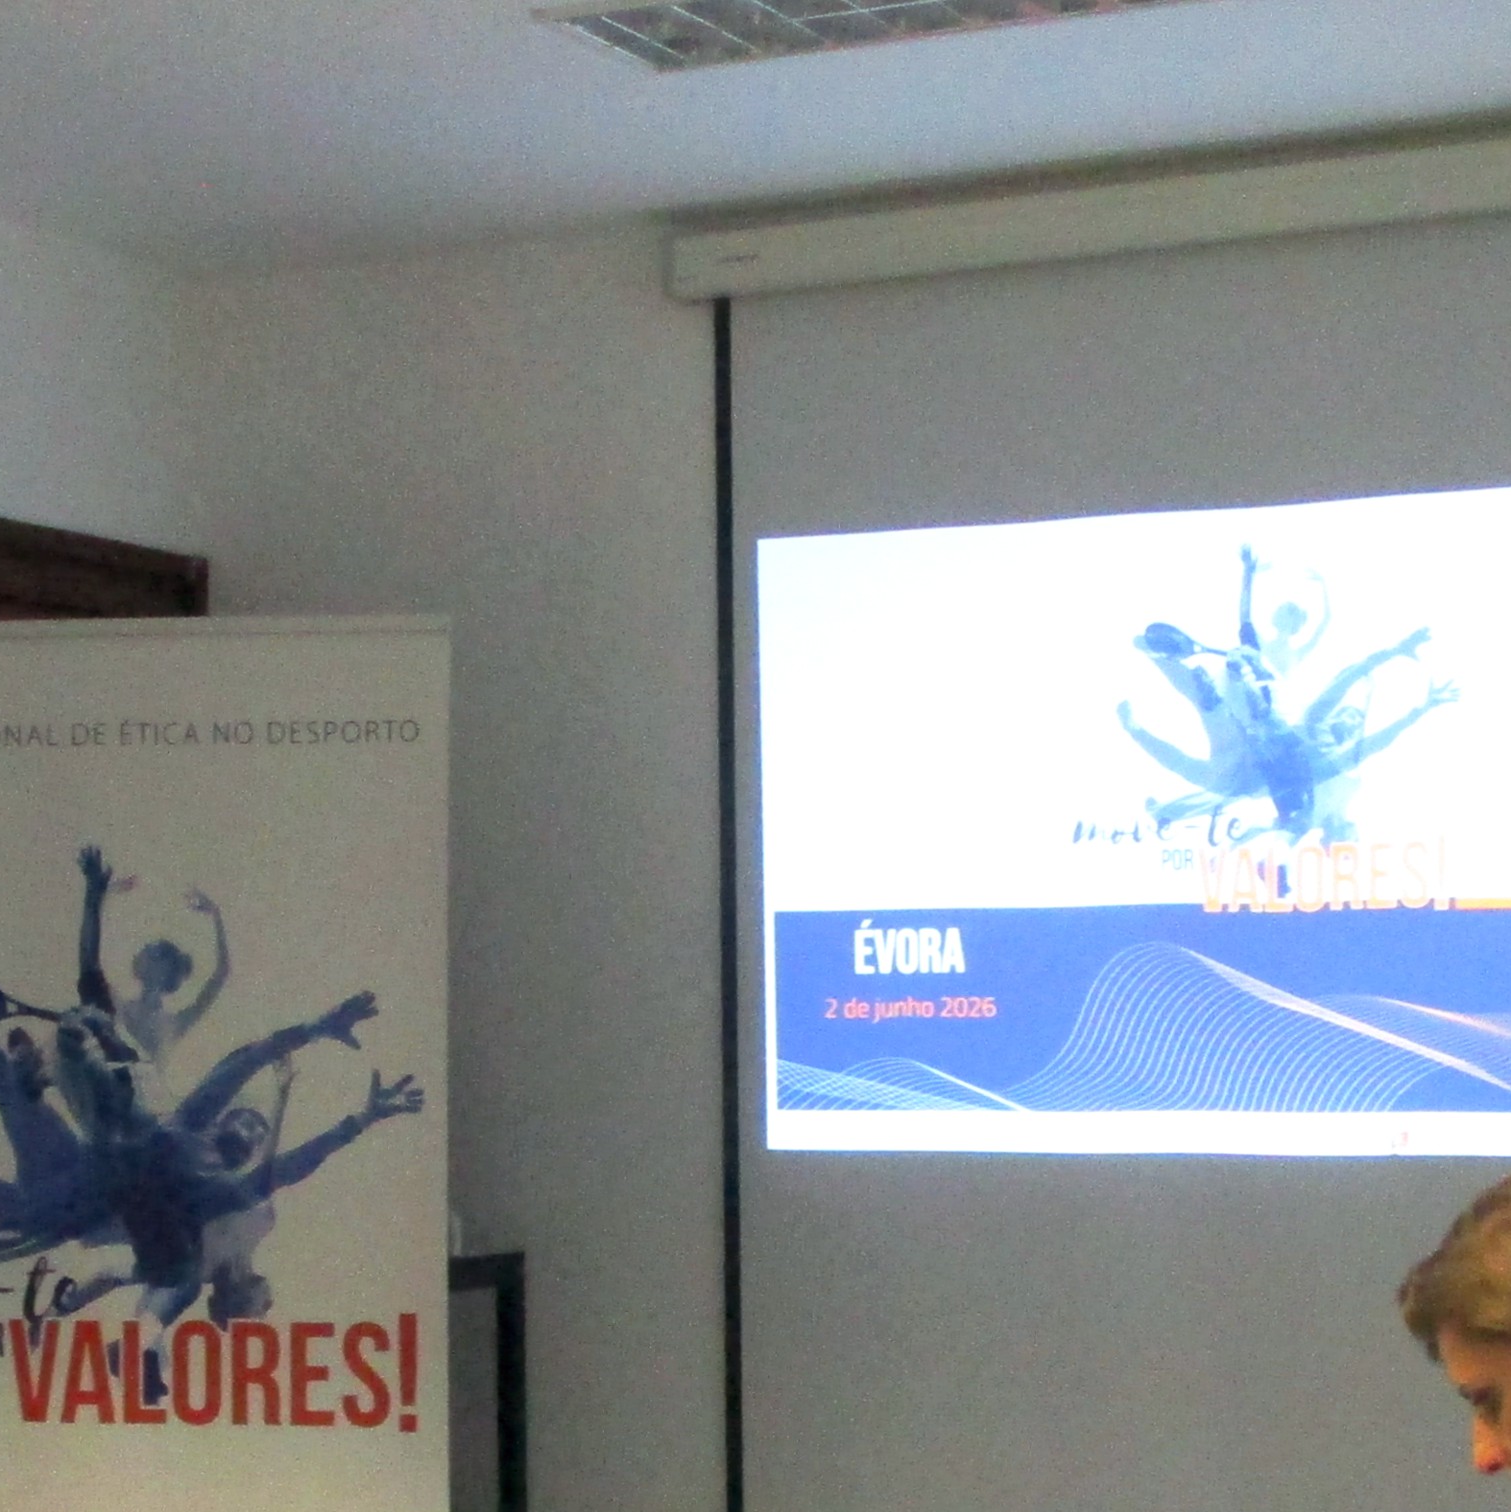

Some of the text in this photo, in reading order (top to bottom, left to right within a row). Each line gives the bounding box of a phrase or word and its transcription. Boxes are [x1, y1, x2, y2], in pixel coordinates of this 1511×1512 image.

[71, 722, 107, 747] DE
[120, 719, 200, 746] ÉTICA
[212, 721, 254, 745] NO
[266, 719, 421, 745] DESPORTO
[1161, 836, 1451, 912] POR VALORES!
[854, 919, 966, 975] ÉVORA
[824, 996, 998, 1024] 2 de junho 2026
[7, 1313, 420, 1434] VALORES!
